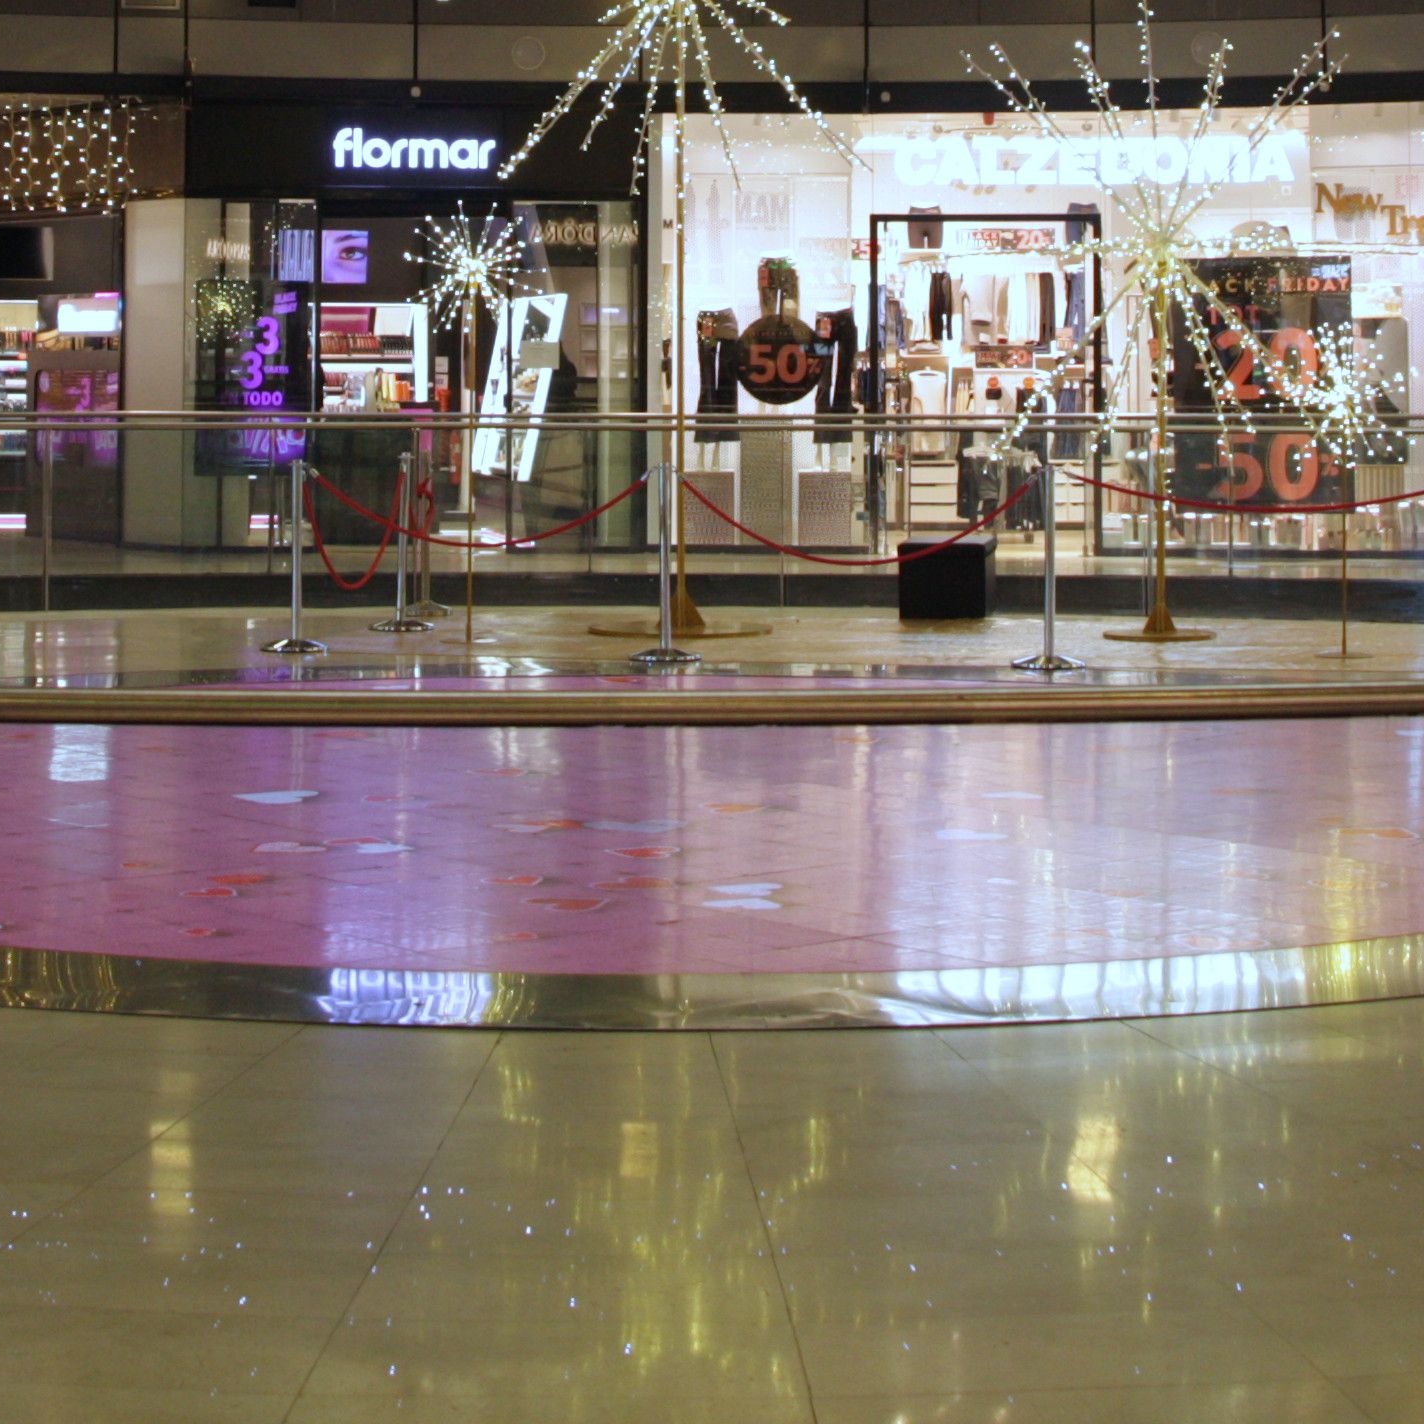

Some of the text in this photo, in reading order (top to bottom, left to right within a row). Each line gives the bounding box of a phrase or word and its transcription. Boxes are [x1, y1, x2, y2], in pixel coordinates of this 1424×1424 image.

[333, 127, 497, 169] flormar
[893, 135, 1295, 186] CALZEDONIA
[1315, 182, 1383, 214] New
[256, 316, 279, 355] 3
[239, 351, 263, 390] 3
[739, 343, 821, 384] -50%
[243, 392, 283, 406] TODO
